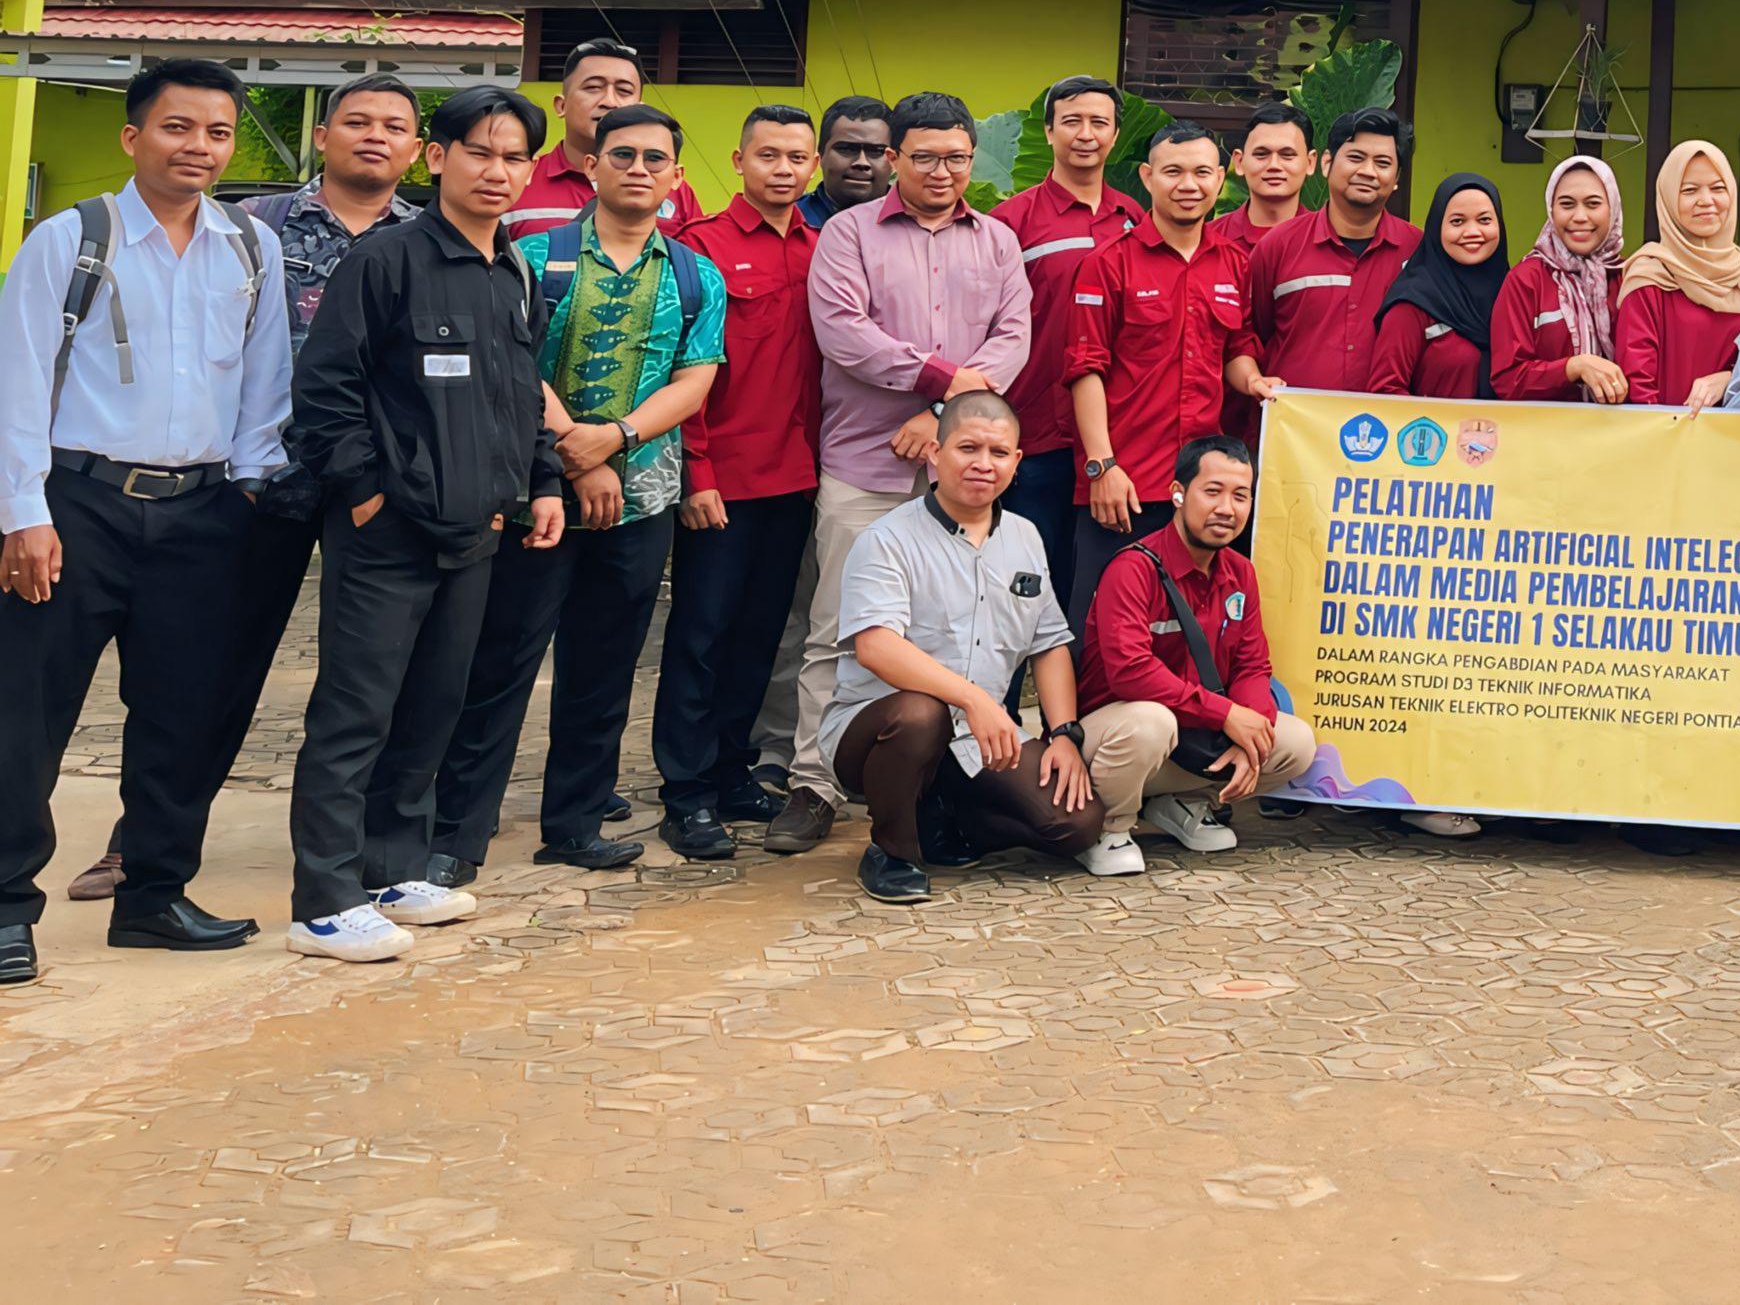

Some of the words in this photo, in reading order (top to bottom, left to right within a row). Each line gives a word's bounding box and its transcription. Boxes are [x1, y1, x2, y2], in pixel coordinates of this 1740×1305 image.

[1332, 476, 1494, 521] PELATIHAN
[1327, 520, 1485, 561] PENERAPAN
[1494, 529, 1635, 569] ARTIFICIAL
[1323, 560, 1421, 598] DALAM
[1430, 566, 1517, 604] MEDIA
[1320, 601, 1346, 635] DI
[1354, 602, 1418, 639] SMK
[1427, 606, 1521, 644] NEGERI
[1532, 612, 1543, 646] 1
[1552, 613, 1672, 653] SELAKAU
[1317, 647, 1374, 662] DALAM
[1379, 650, 1448, 667] RANGKA
[1453, 654, 1557, 673] PENGABDIAN
[1562, 660, 1606, 675] PADA
[1611, 663, 1730, 682] MASYARAKAT
[1315, 670, 1396, 687] PROGRAM
[1401, 674, 1448, 690] STUDI
[1453, 677, 1473, 690] D3
[1478, 679, 1533, 695] TEKNIK
[1538, 682, 1652, 701] INFORMATIKA
[1313, 692, 1384, 709] JURUSAN
[1389, 696, 1445, 713] TEKNIK
[1450, 700, 1519, 717] ELEKTRO
[1524, 704, 1617, 722] POLITEKNIK
[1621, 709, 1678, 726] NEGERI
[1313, 715, 1364, 731] TAHUN
[1369, 718, 1407, 734] 2024
